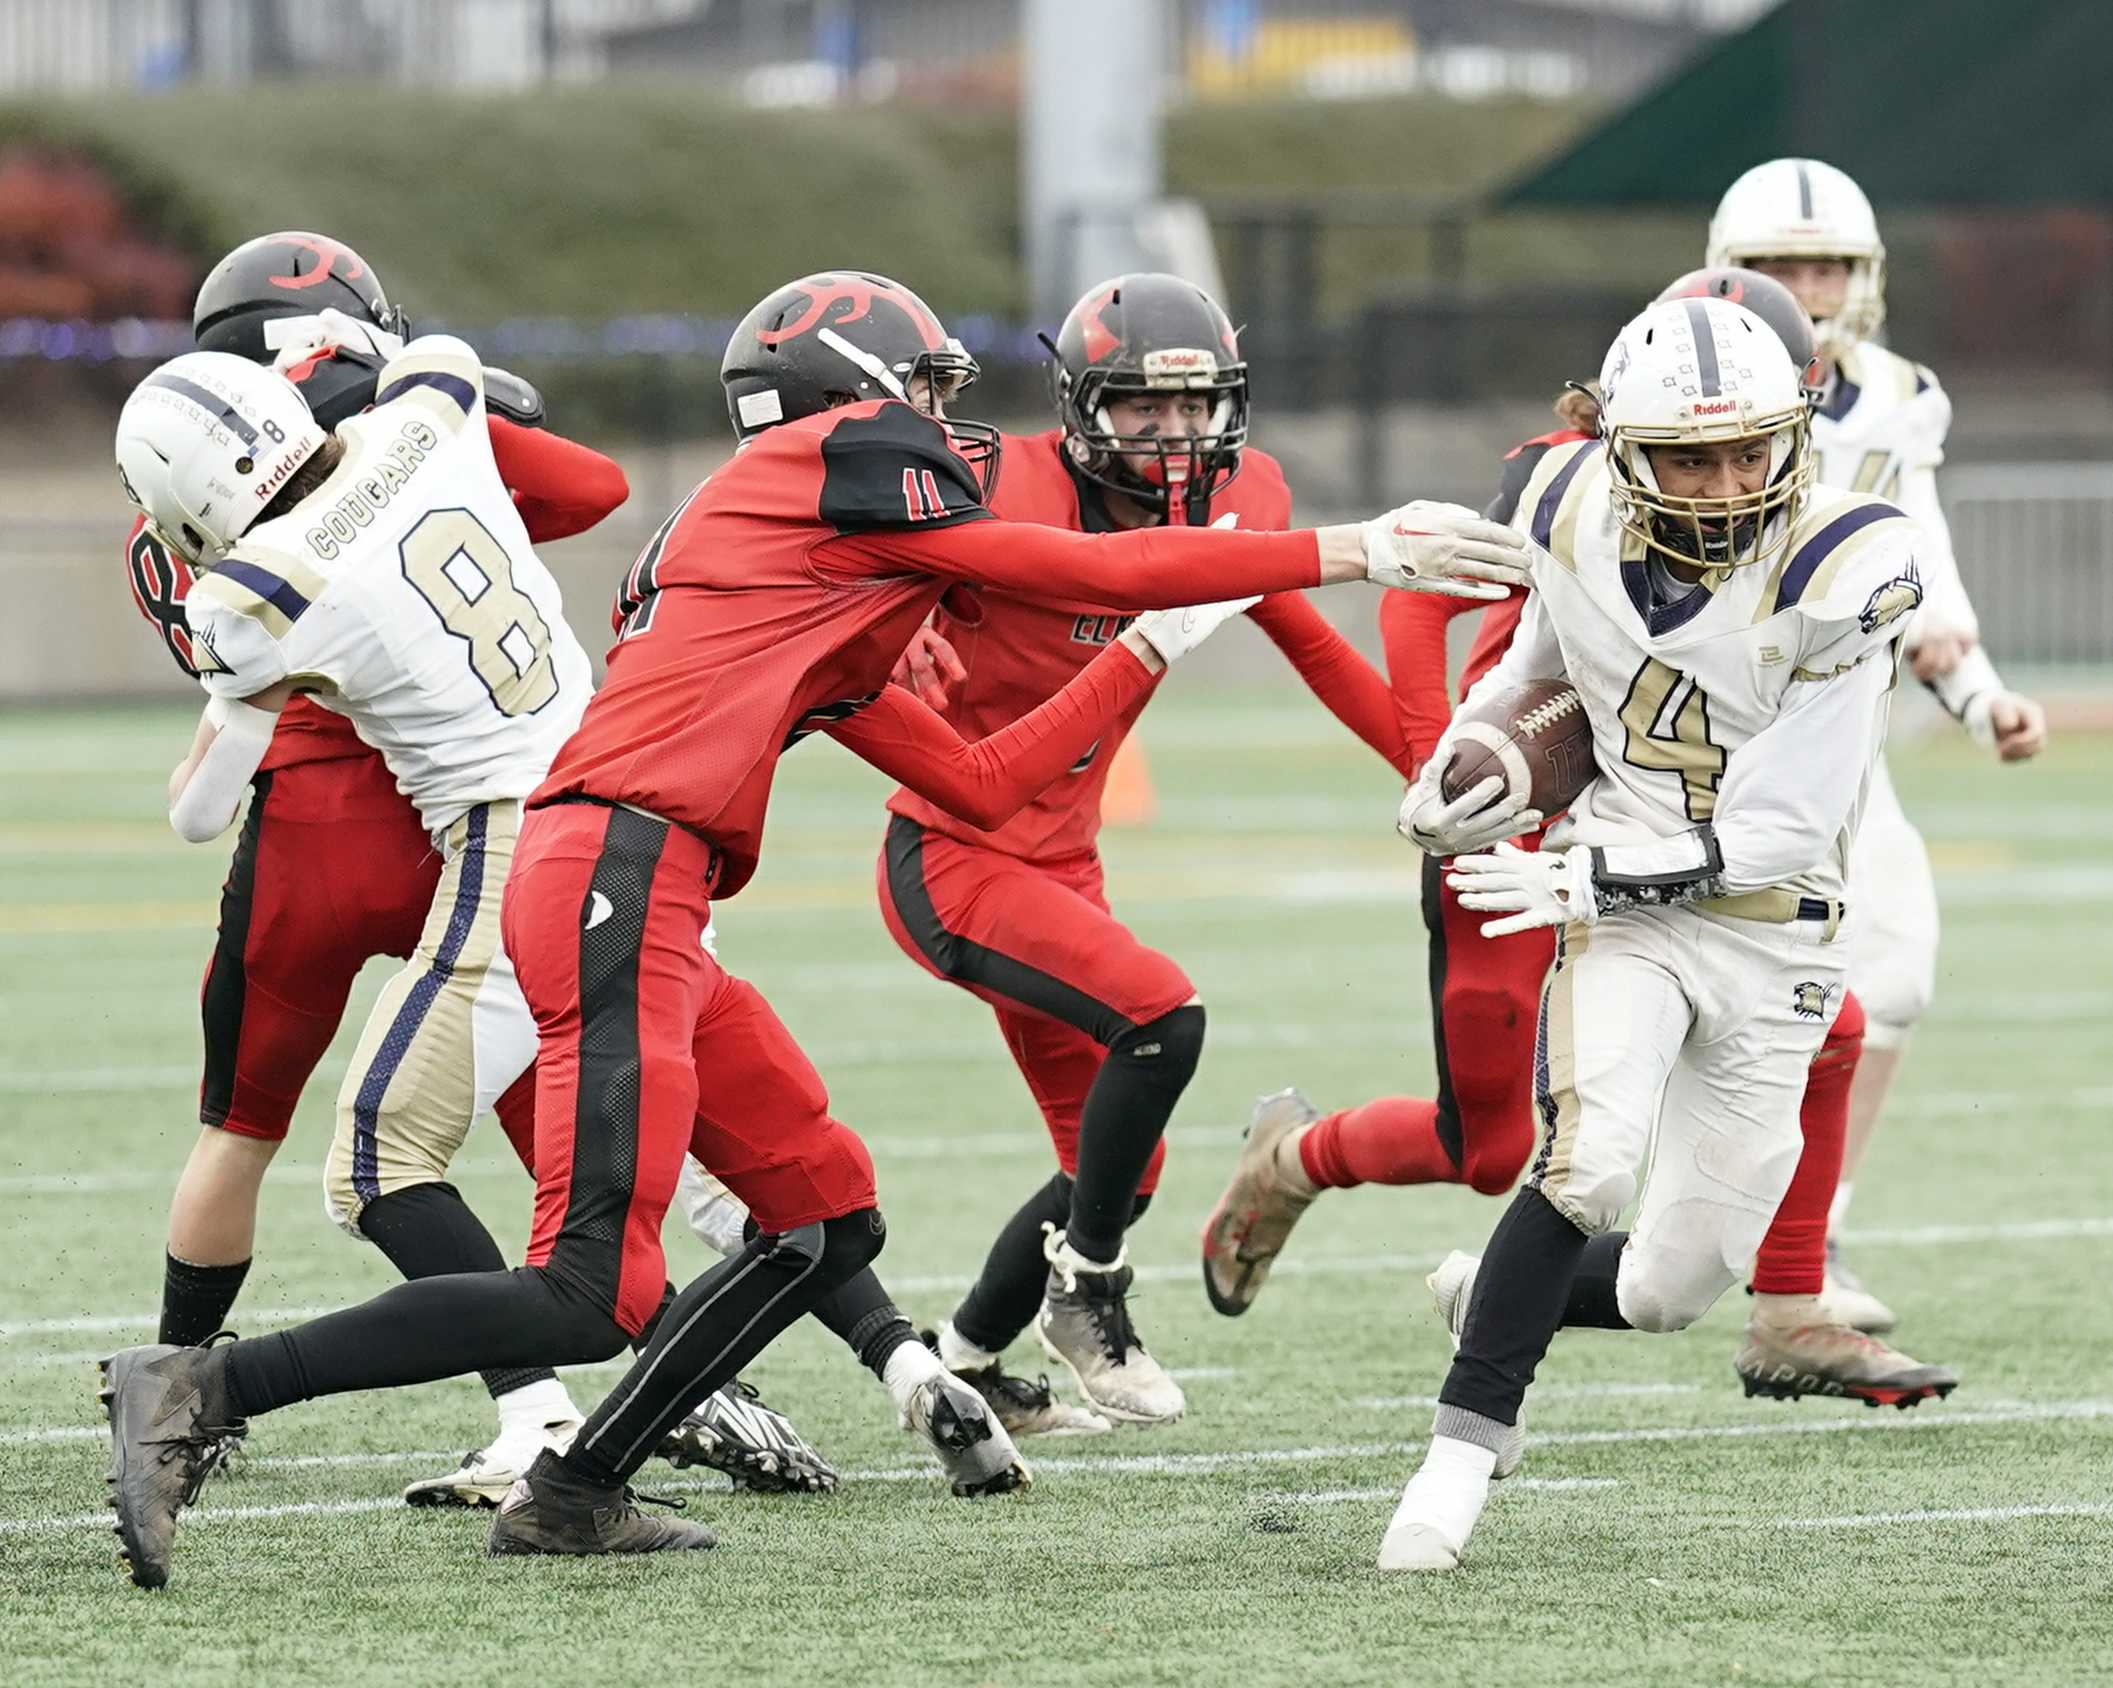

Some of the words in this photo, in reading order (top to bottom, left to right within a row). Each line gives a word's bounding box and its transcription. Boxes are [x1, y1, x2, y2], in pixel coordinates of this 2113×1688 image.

[262, 418, 286, 445] 8
[1693, 400, 1737, 416] Riddell
[255, 436, 312, 500] Riddell
[305, 420, 437, 561] COUGARS
[902, 467, 952, 522] 11
[397, 506, 560, 718] 8
[1616, 654, 1728, 824] 4
